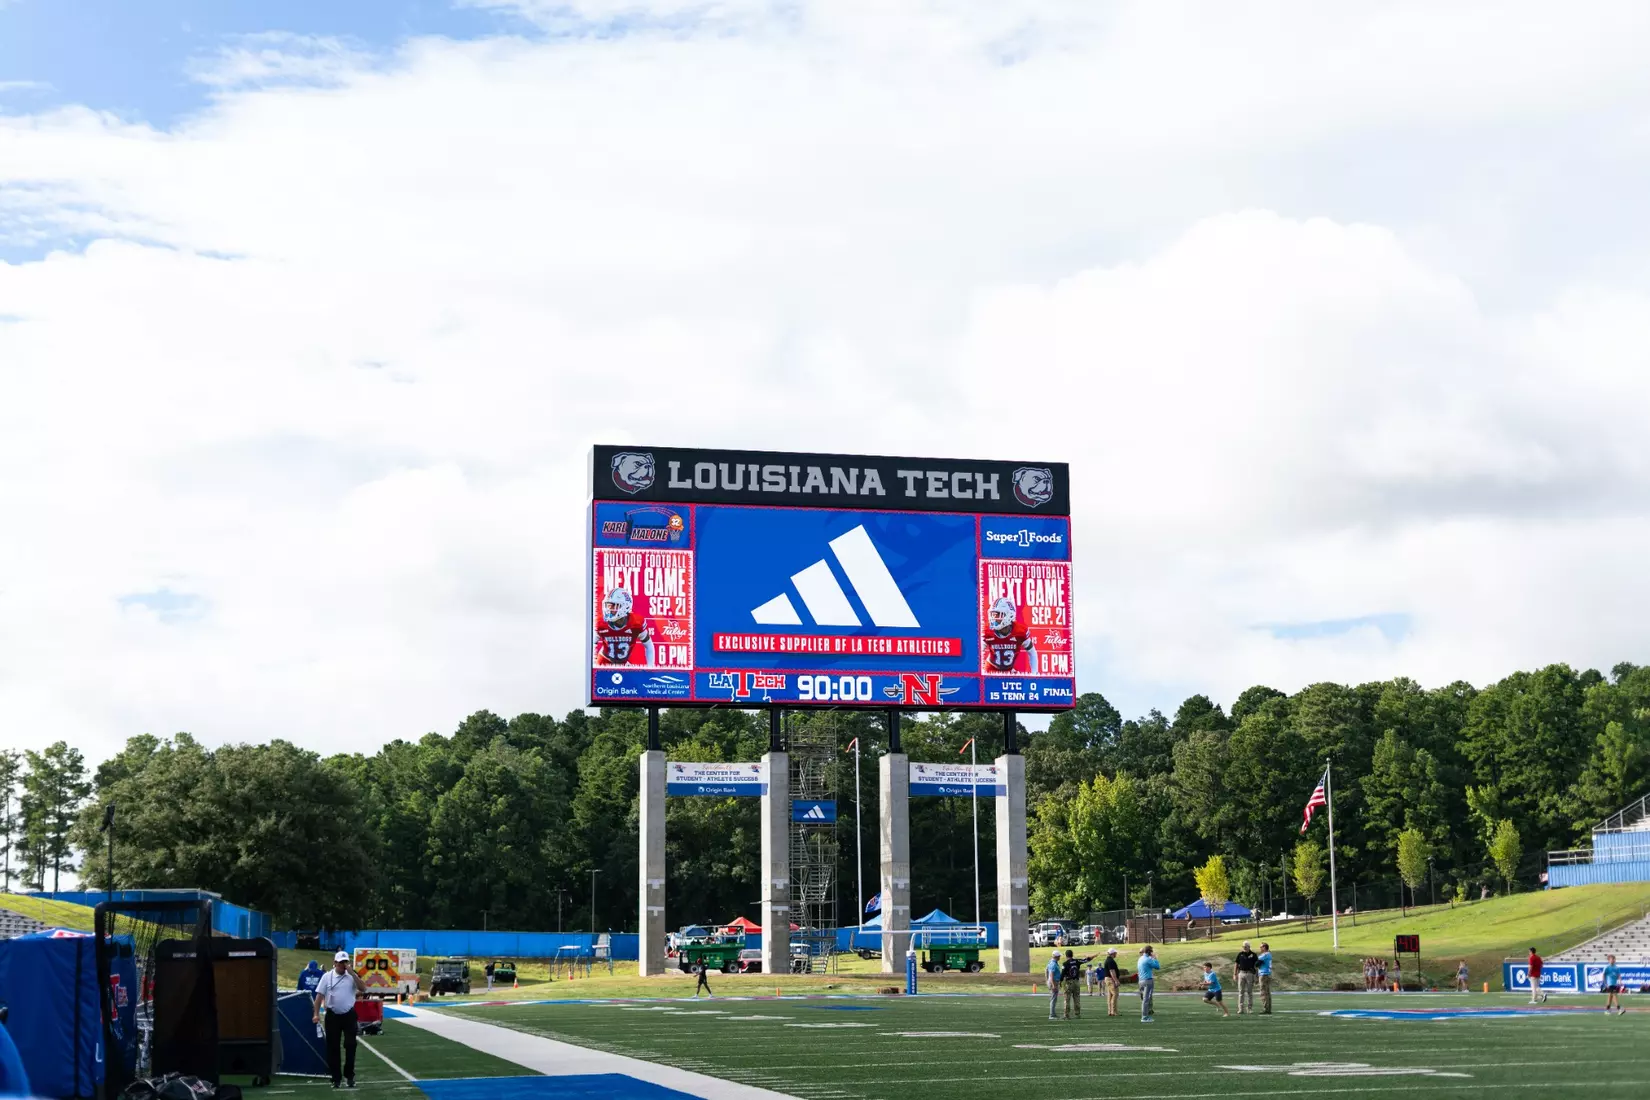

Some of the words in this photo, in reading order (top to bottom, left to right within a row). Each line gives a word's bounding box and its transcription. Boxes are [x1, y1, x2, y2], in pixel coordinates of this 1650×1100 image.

[668, 461, 886, 496] LOUISIANA
[897, 470, 1000, 499] TECH
[602, 521, 627, 534] KARL
[671, 518, 681, 526] 32
[631, 528, 669, 541] MALONE
[986, 531, 1018, 544] Super
[1018, 529, 1030, 547] 1
[1029, 532, 1062, 543] Foods
[603, 552, 642, 567] BULLDOG
[645, 554, 686, 569] FOOTBALL
[988, 564, 1024, 578] BULLDOG
[1026, 566, 1065, 580] FOOTBALL
[603, 566, 641, 596] NEXT
[643, 567, 686, 597] GAME
[988, 578, 1023, 606] NEXT
[1025, 578, 1065, 607] GAME
[649, 596, 673, 616] SEP.
[675, 597, 686, 616] 21
[1031, 606, 1053, 625] SEP.
[1055, 607, 1066, 626] 21
[661, 625, 687, 637] Tulsa
[719, 636, 775, 650] EXCLUSIVE
[780, 637, 830, 652] SUPPLIER
[835, 638, 847, 652] OF
[851, 638, 863, 652] LA
[867, 639, 892, 653] TECH
[897, 640, 951, 654] ATHLETICS
[1043, 634, 1068, 645] Tulsa
[609, 642, 630, 659] 13
[658, 645, 667, 665] 6
[668, 645, 687, 665] PM
[995, 650, 1015, 666] 13
[1041, 654, 1049, 672] 6
[1051, 654, 1068, 672] PM
[709, 673, 733, 688] LA
[797, 675, 873, 701] 90:00
[1002, 682, 1022, 690] UTC
[597, 687, 619, 696] Origin
[620, 687, 638, 695] Bank
[900, 673, 943, 705] N
[990, 692, 1000, 700] 15
[1002, 692, 1025, 701] TENN
[1029, 692, 1039, 701] 24
[1043, 688, 1073, 697] FINAL
[1552, 972, 1572, 983] Bank
